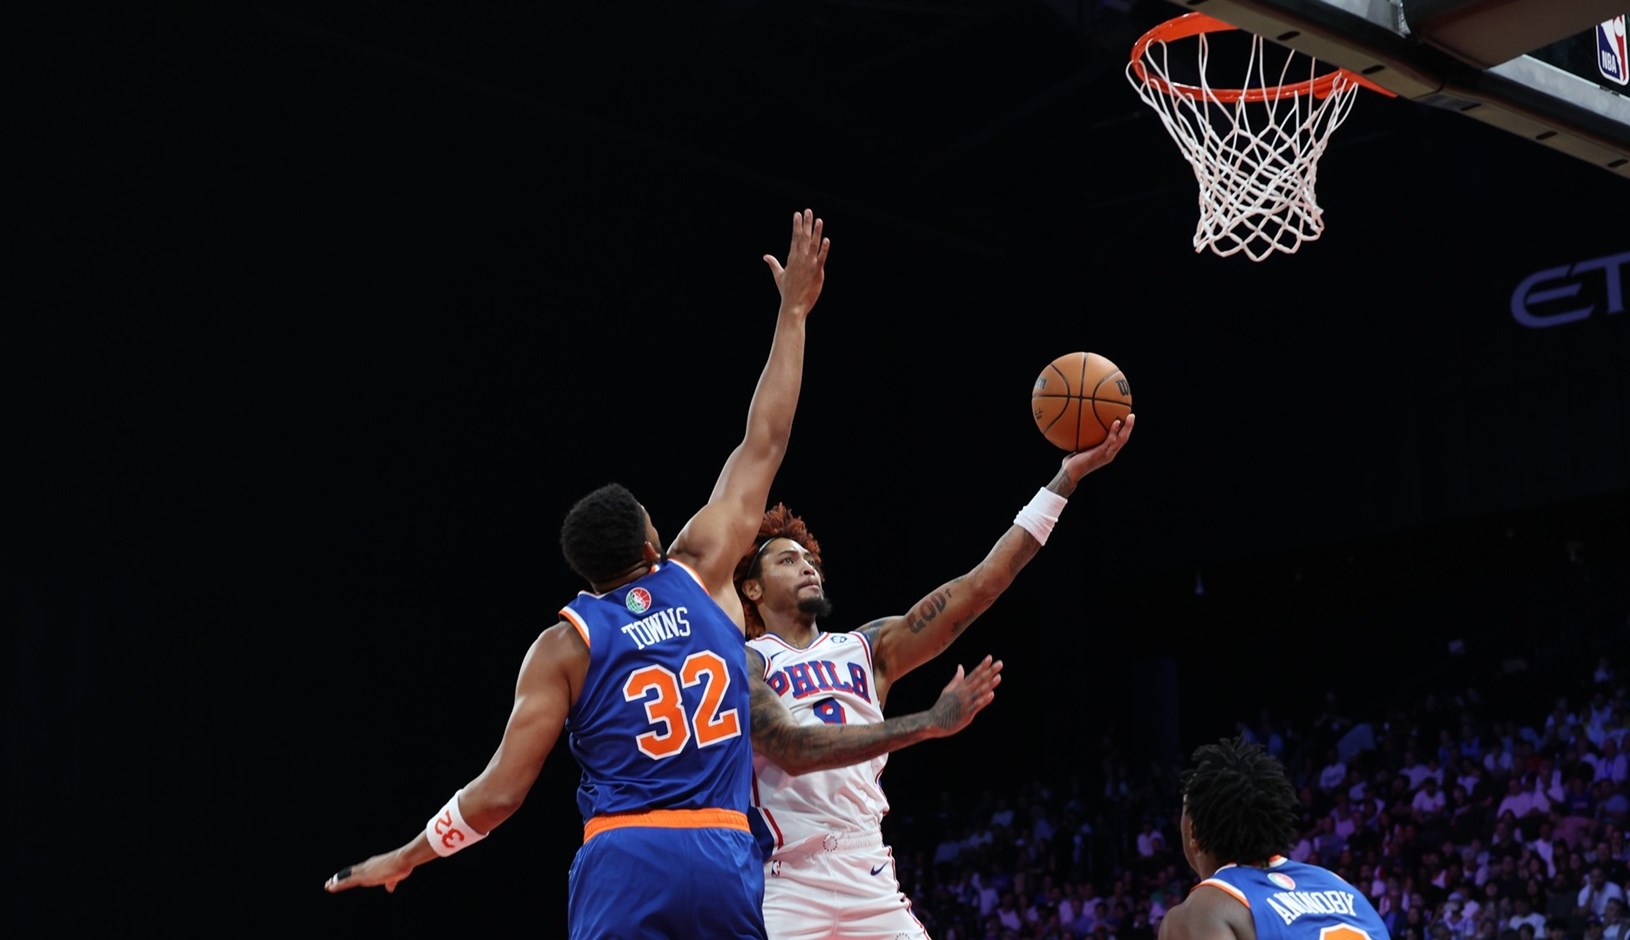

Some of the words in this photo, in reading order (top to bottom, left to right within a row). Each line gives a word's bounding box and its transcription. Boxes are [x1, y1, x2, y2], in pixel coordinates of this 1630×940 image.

[1601, 50, 1618, 74] NBA
[1511, 251, 1630, 328] ET
[621, 607, 691, 650] TOWNS
[766, 660, 872, 704] PHILA
[623, 649, 742, 761] 32
[434, 809, 465, 849] 32
